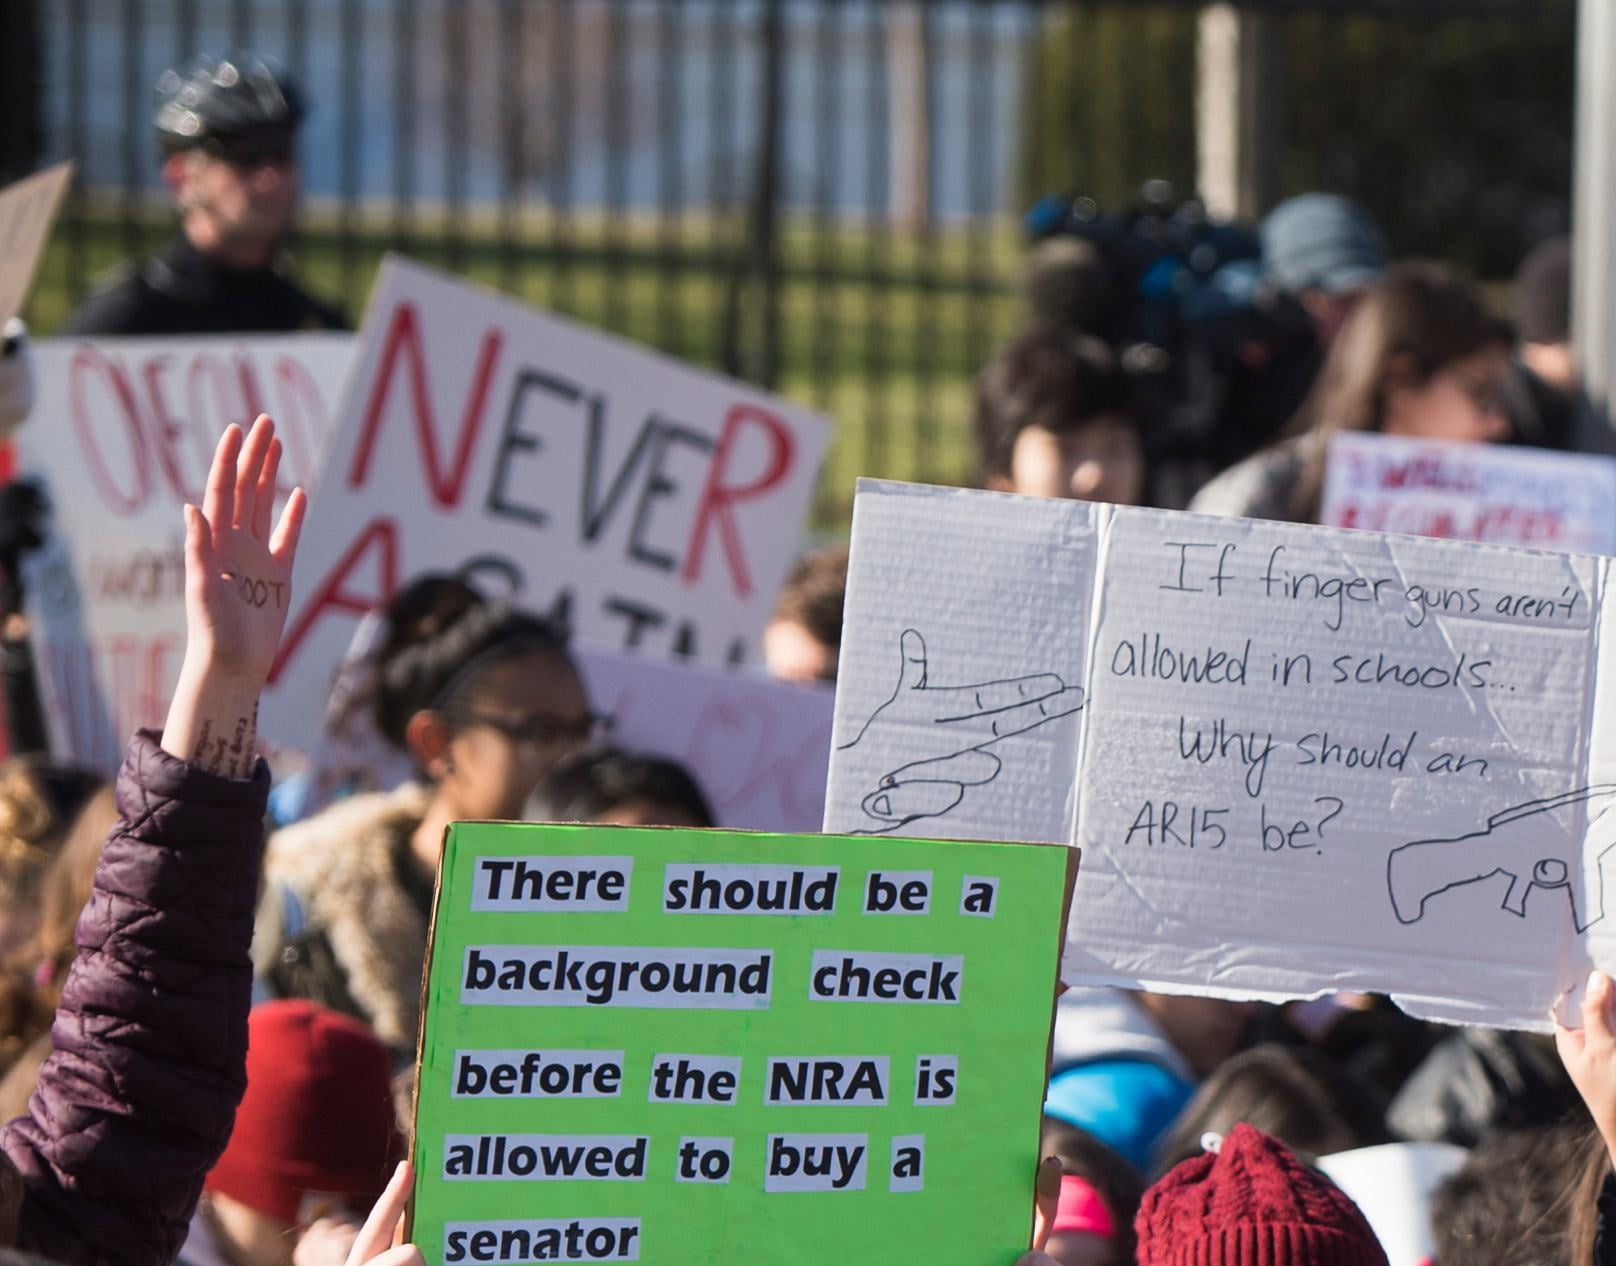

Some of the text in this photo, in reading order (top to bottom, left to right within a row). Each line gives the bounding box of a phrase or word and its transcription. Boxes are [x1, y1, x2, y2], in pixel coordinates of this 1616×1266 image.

[349, 302, 797, 597] NEVER
[1160, 542, 1579, 631] If finger guns aren't
[1111, 633, 1516, 692] allowed in schools...
[1178, 716, 1489, 797] Why should an
[1125, 796, 1344, 855] AR15 be?
[481, 860, 993, 914] There should be a
[464, 949, 960, 1004] background check
[456, 1053, 955, 1102] before the NRA is
[445, 1135, 922, 1188] allowed to buy a
[445, 1221, 638, 1262] senator
